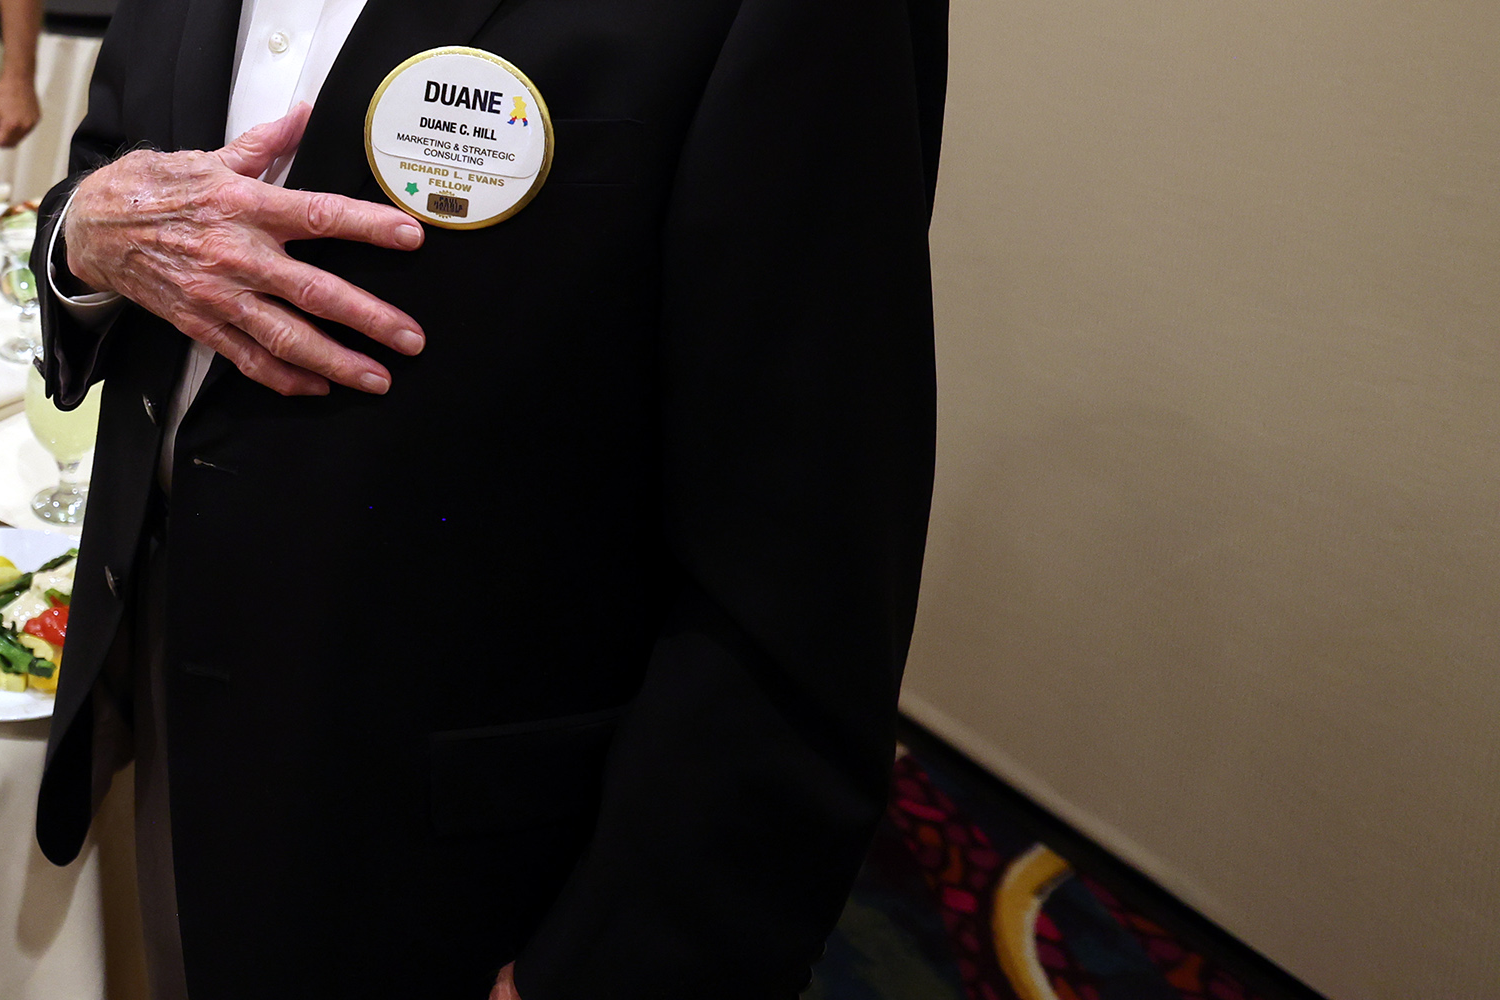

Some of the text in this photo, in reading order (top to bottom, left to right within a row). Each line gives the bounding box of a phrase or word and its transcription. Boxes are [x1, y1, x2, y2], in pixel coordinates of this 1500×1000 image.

[424, 80, 503, 114] DUANE
[419, 116, 497, 141] DUANE C. HILL
[396, 132, 516, 161] MARKETING & STRATEGIC
[423, 148, 484, 166] CONSULTING
[400, 161, 505, 187] RICHARD L. EVANS
[428, 177, 472, 192] FELLOW
